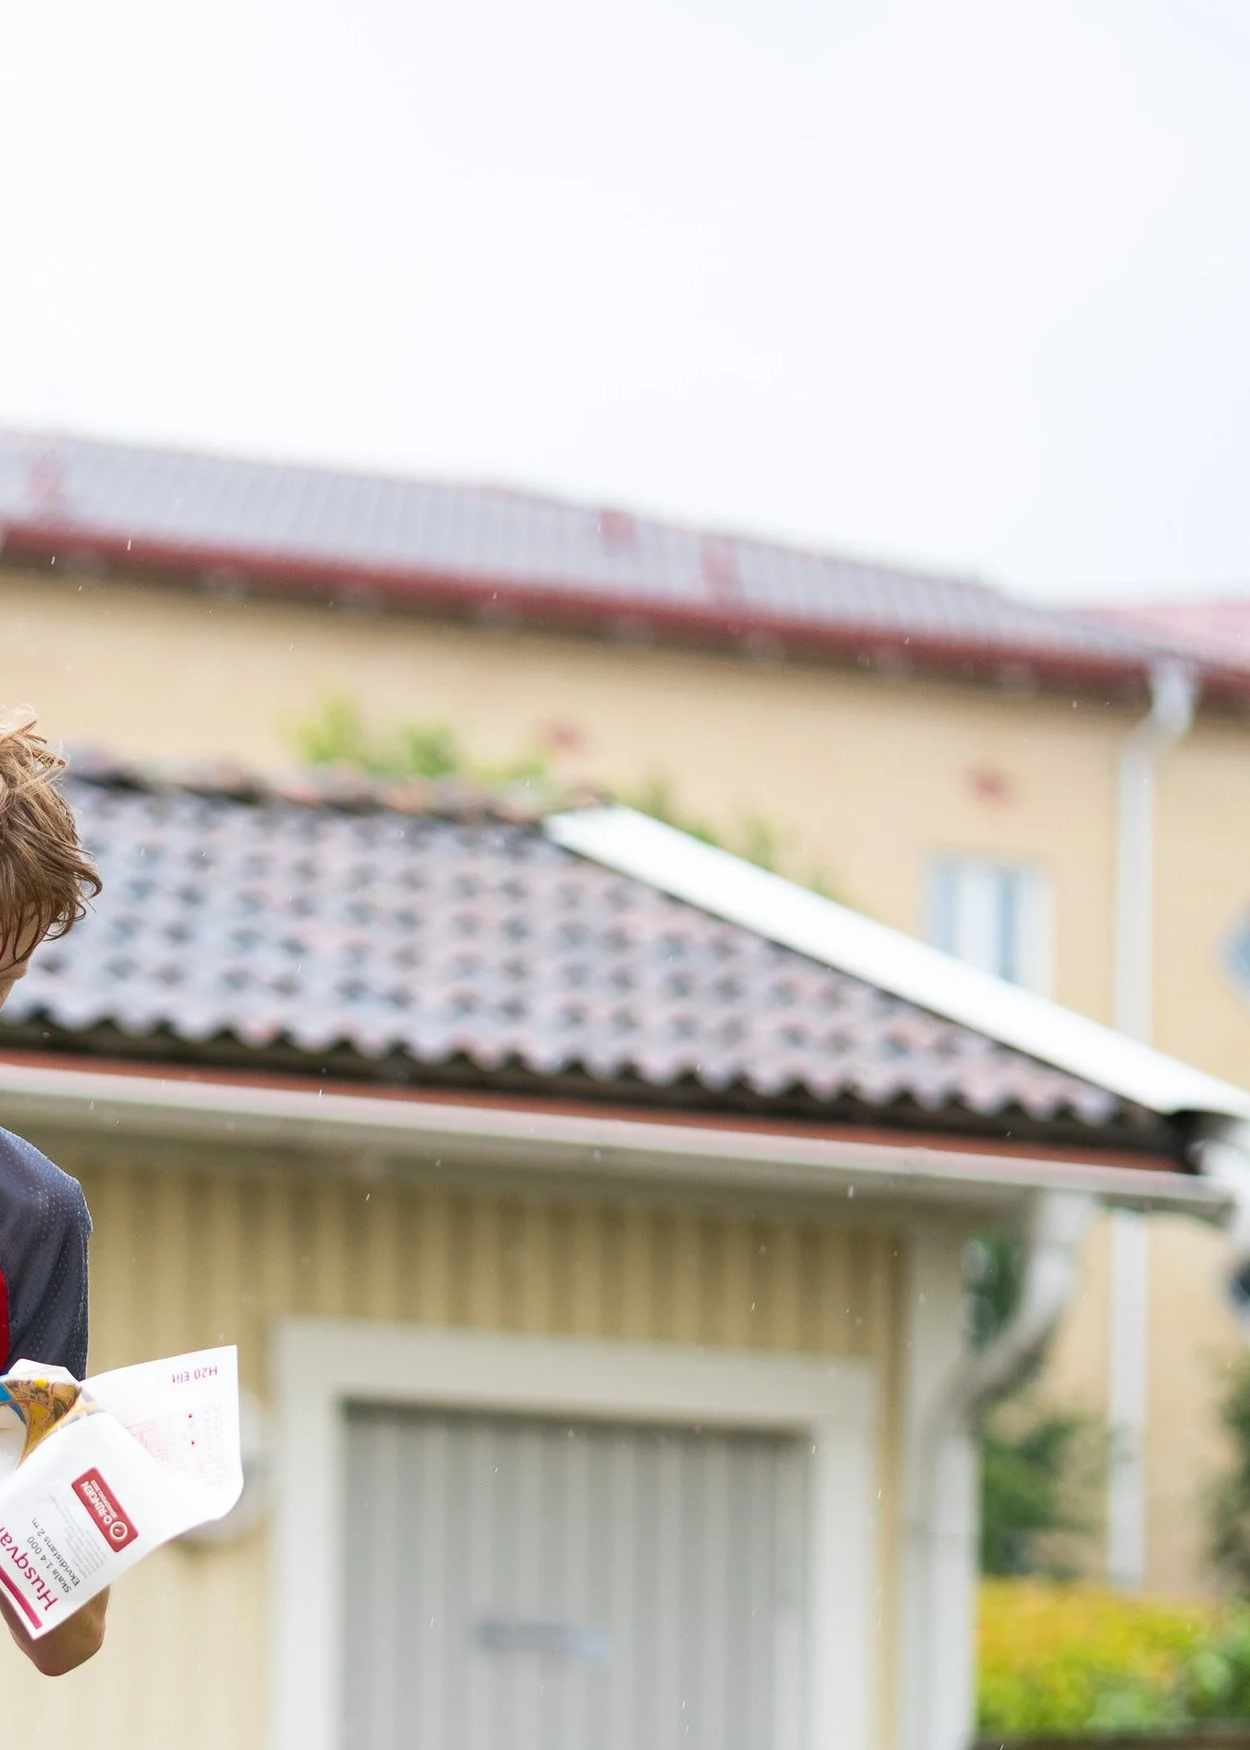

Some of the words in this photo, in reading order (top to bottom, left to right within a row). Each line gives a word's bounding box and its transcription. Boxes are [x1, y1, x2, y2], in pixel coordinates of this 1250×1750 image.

[194, 1365, 218, 1380] H20
[31, 1518, 40, 1529] m
[37, 1528, 46, 1537] 2
[43, 1536, 81, 1587] Ekvidistans
[52, 1568, 72, 1593] Skala
